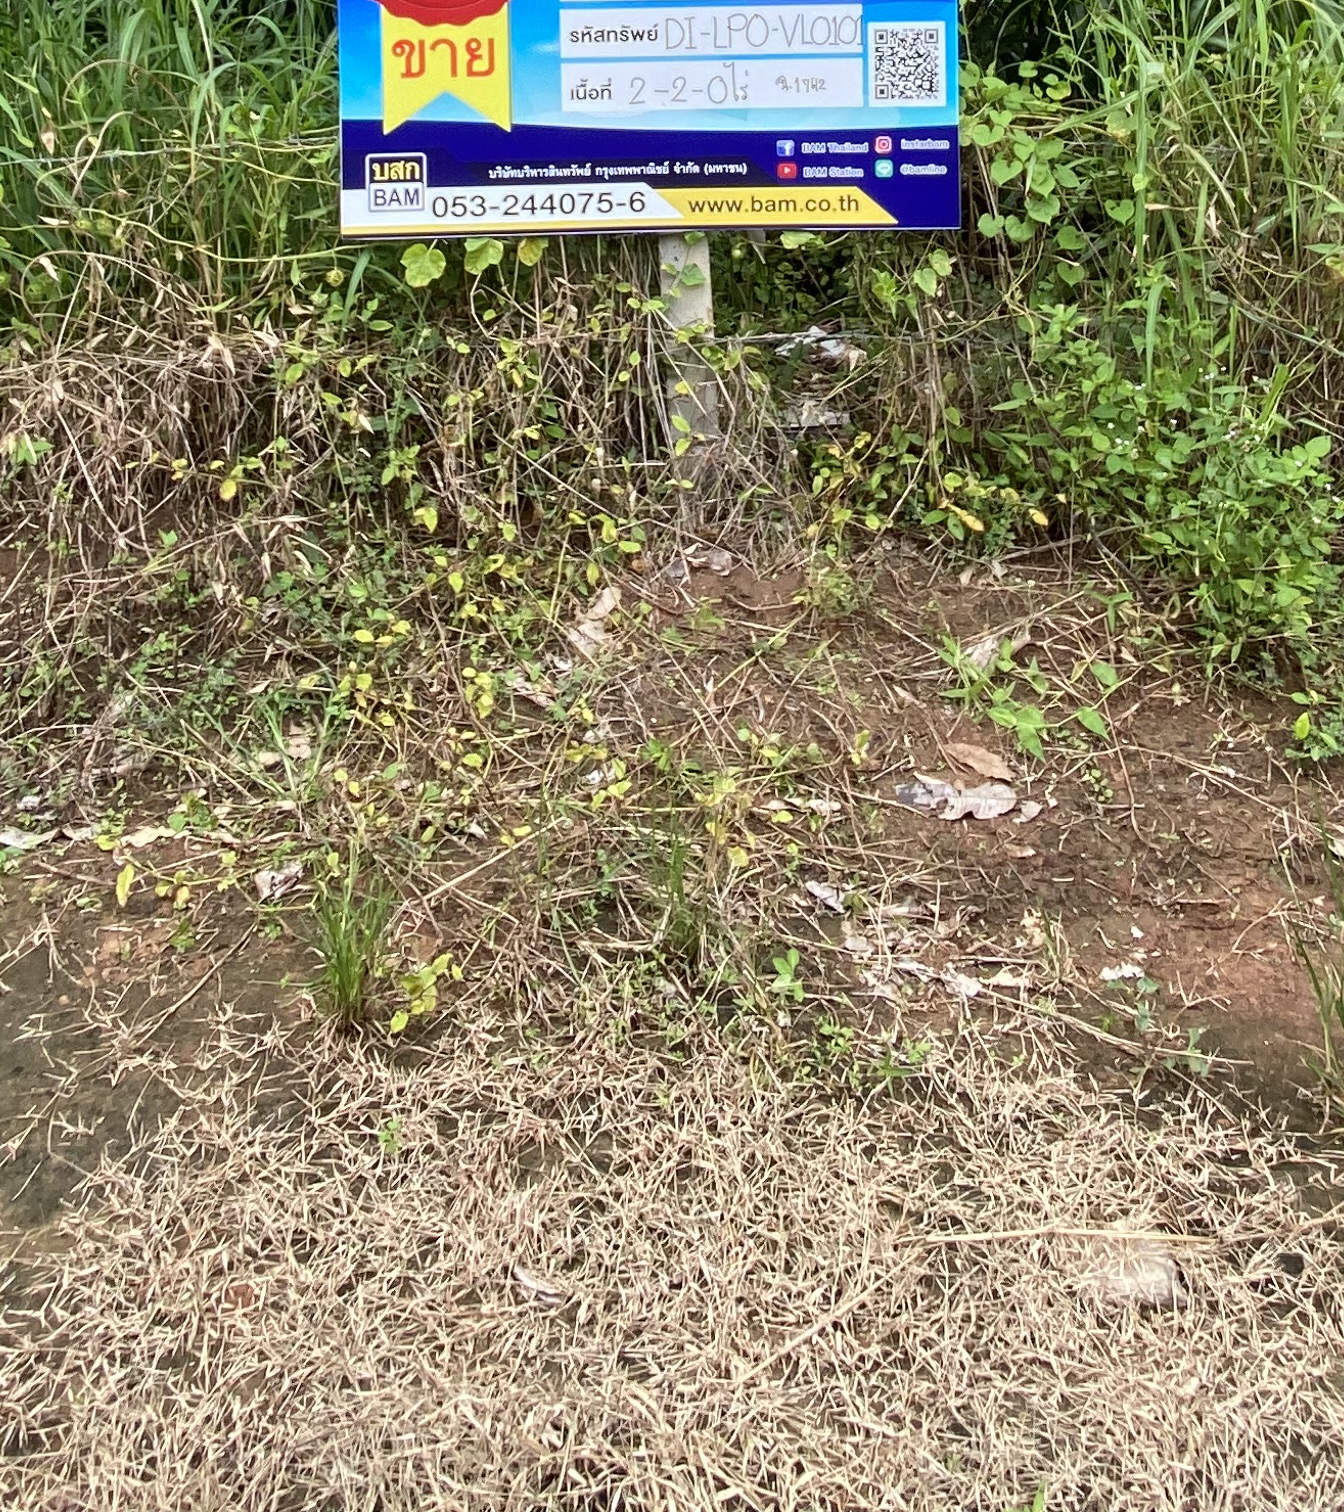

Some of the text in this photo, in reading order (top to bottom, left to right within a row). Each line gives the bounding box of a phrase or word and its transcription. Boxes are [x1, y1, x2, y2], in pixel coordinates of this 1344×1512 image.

[569, 24, 659, 44] รหัสทรัพย์
[392, 38, 495, 78] ขาย
[570, 78, 612, 100] เนื้อที่
[827, 142, 869, 153] Thailand
[372, 161, 420, 181] บสก
[673, 161, 700, 175] จำกัด
[704, 162, 748, 176] (มหาชน)
[373, 188, 420, 207] BAM
[431, 191, 647, 218] 053-244075-6
[688, 195, 860, 213] www.bam.co.th
